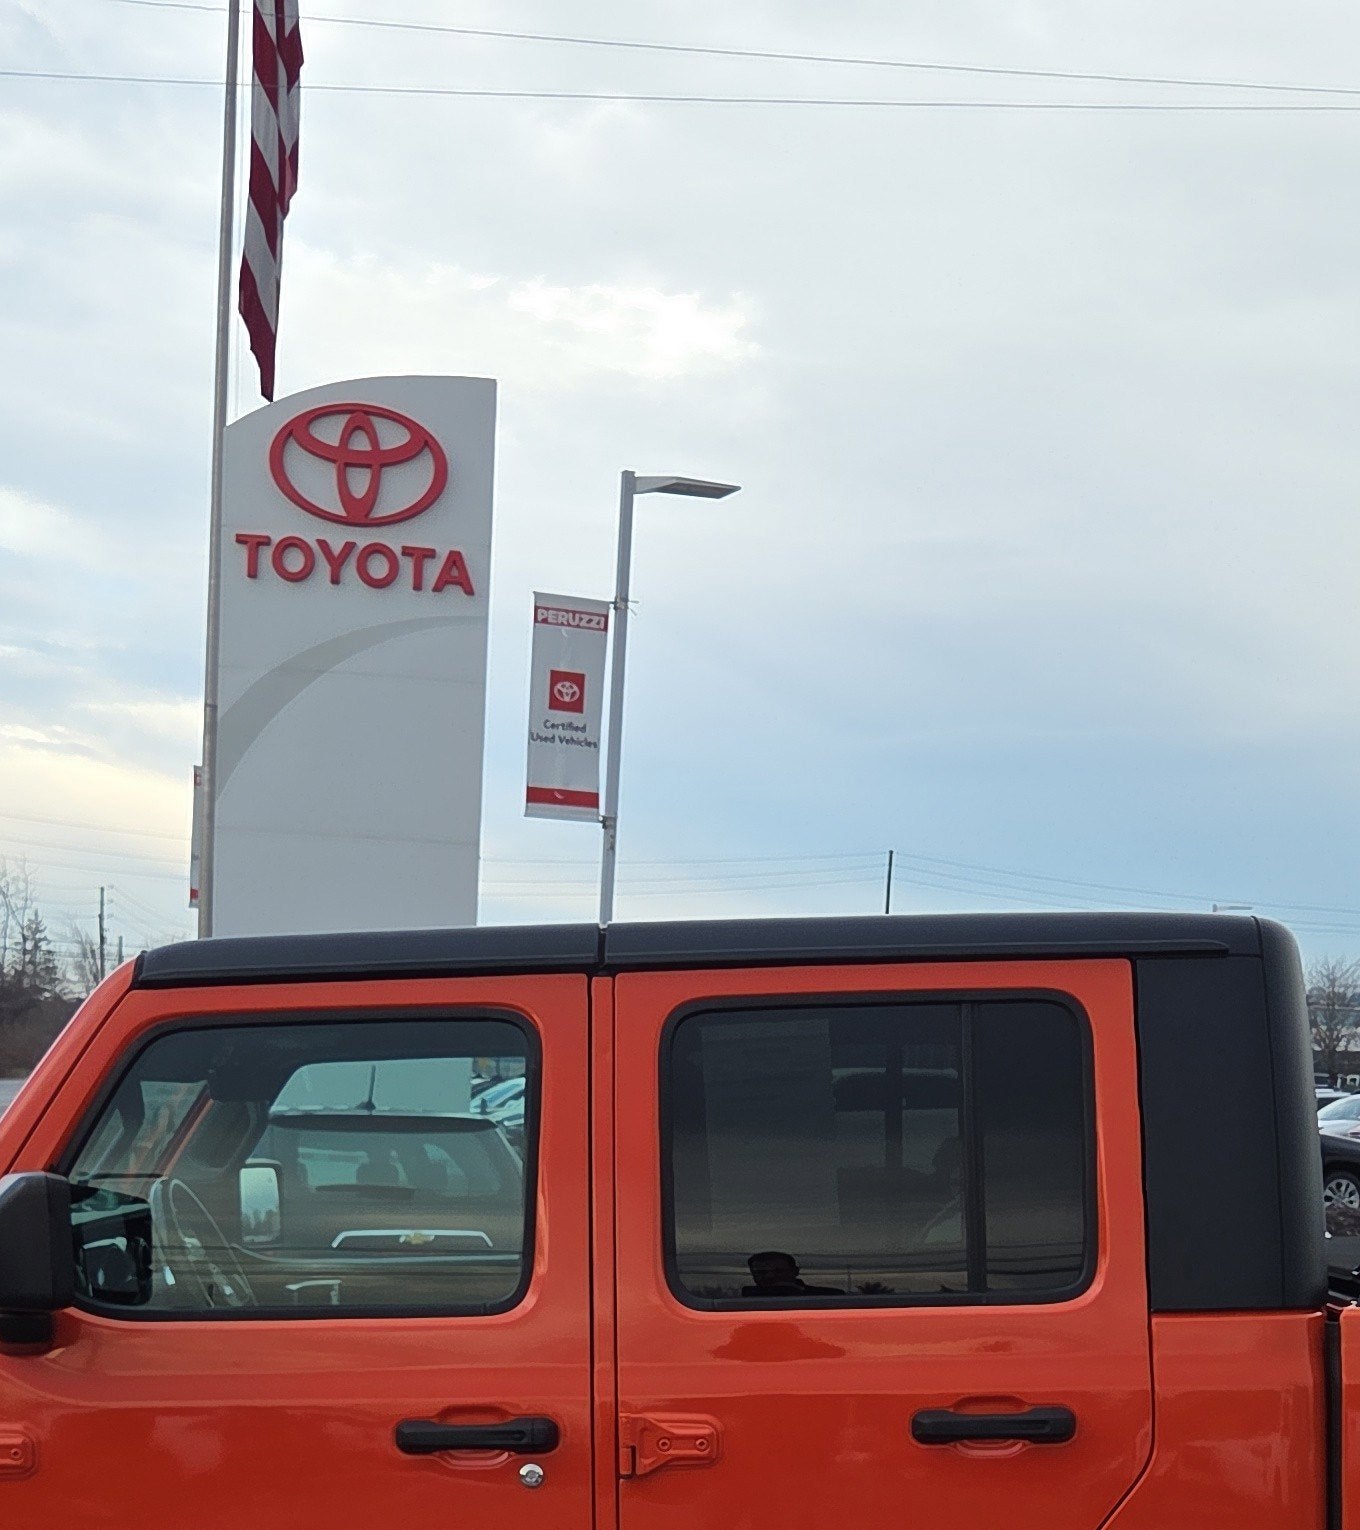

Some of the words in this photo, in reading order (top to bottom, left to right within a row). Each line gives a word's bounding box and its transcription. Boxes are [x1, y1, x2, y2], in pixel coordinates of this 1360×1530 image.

[235, 533, 475, 596] TOYOTA
[537, 608, 605, 630] PERUZZI
[543, 719, 587, 733] Certified
[530, 732, 555, 743] Used
[558, 735, 598, 749] Vehicles
